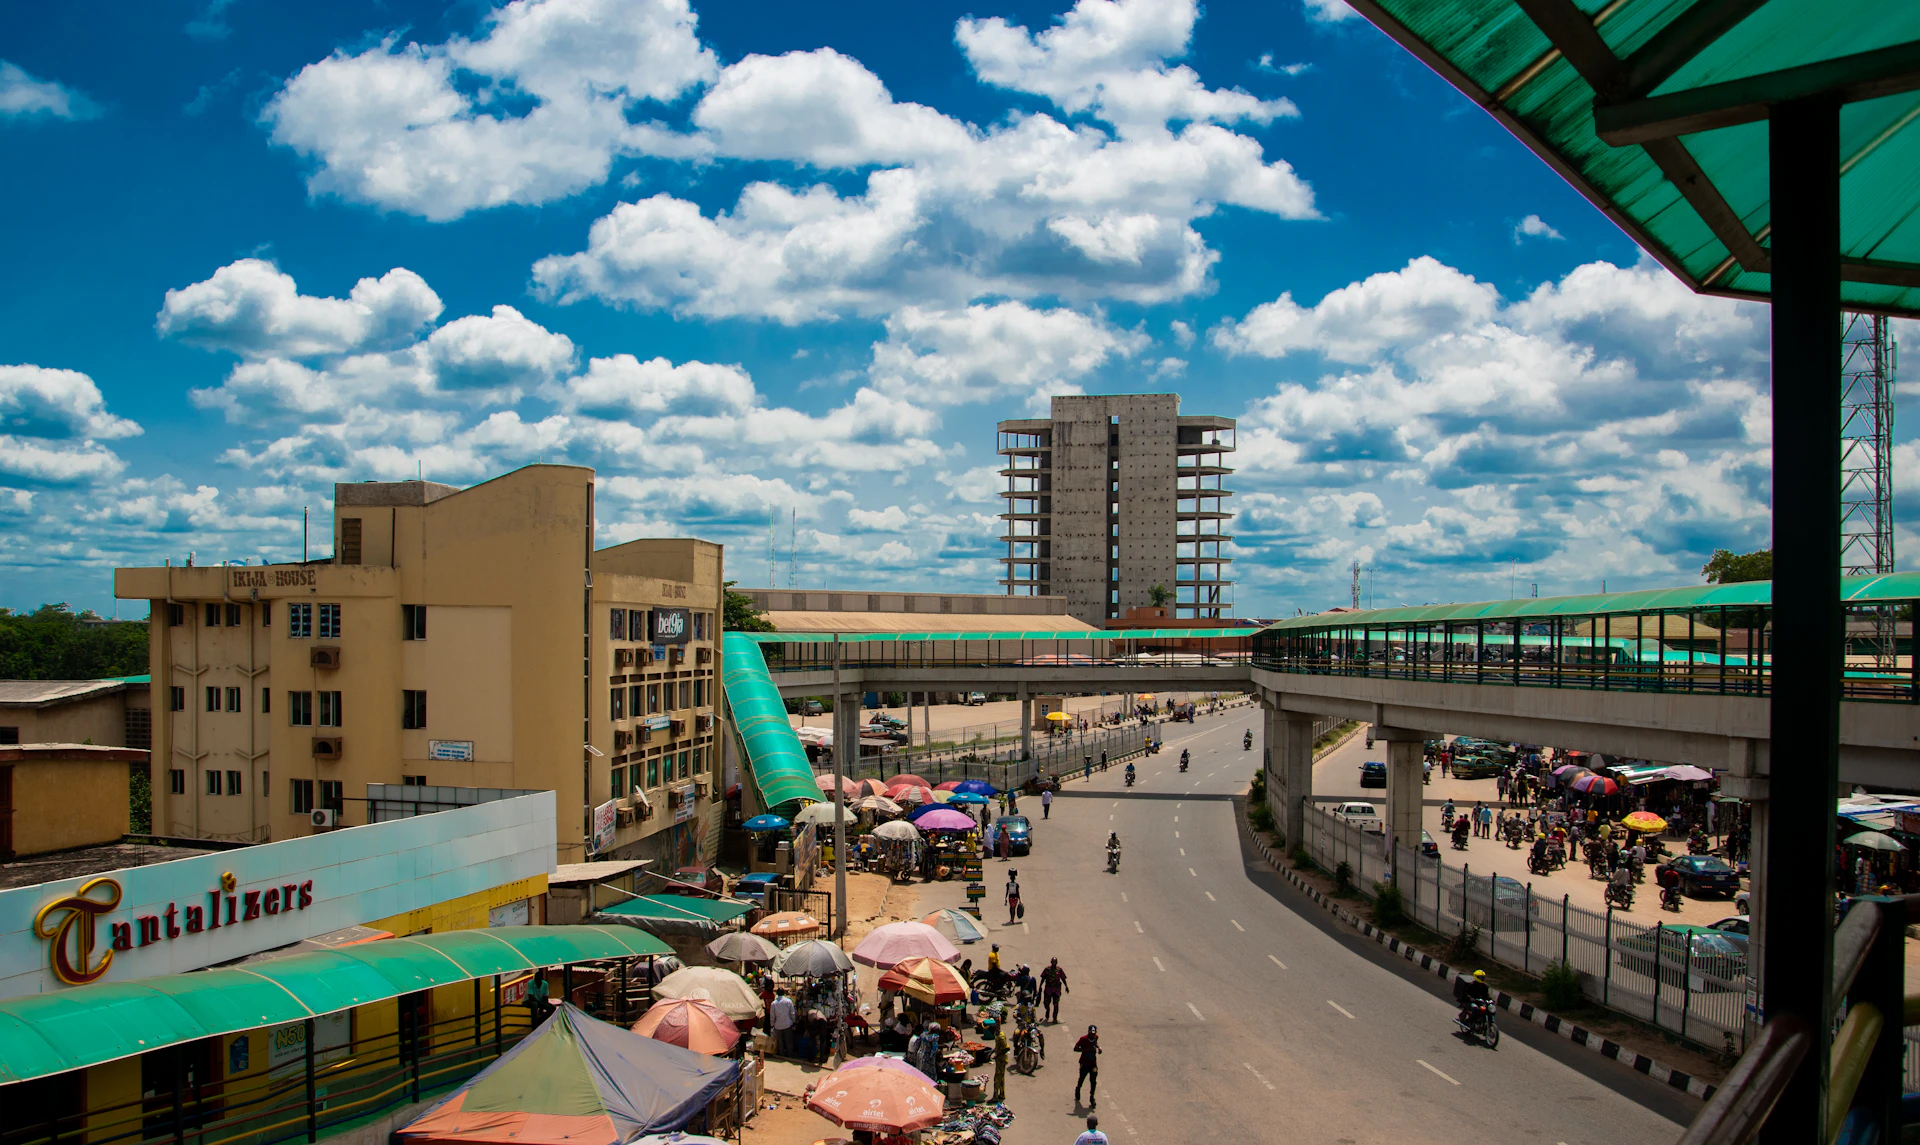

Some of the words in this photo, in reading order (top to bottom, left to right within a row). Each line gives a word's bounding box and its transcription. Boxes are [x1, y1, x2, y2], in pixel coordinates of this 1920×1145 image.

[233, 571, 267, 587] IKIJA
[275, 570, 316, 586] HOUSE
[658, 613, 683, 637] bet9ja
[33, 872, 313, 985] Tantalizers
[825, 1097, 841, 1108] airtel
[863, 1109, 884, 1117] airtel
[908, 1105, 926, 1115] airtel
[853, 1122, 892, 1132] smartSERVE
